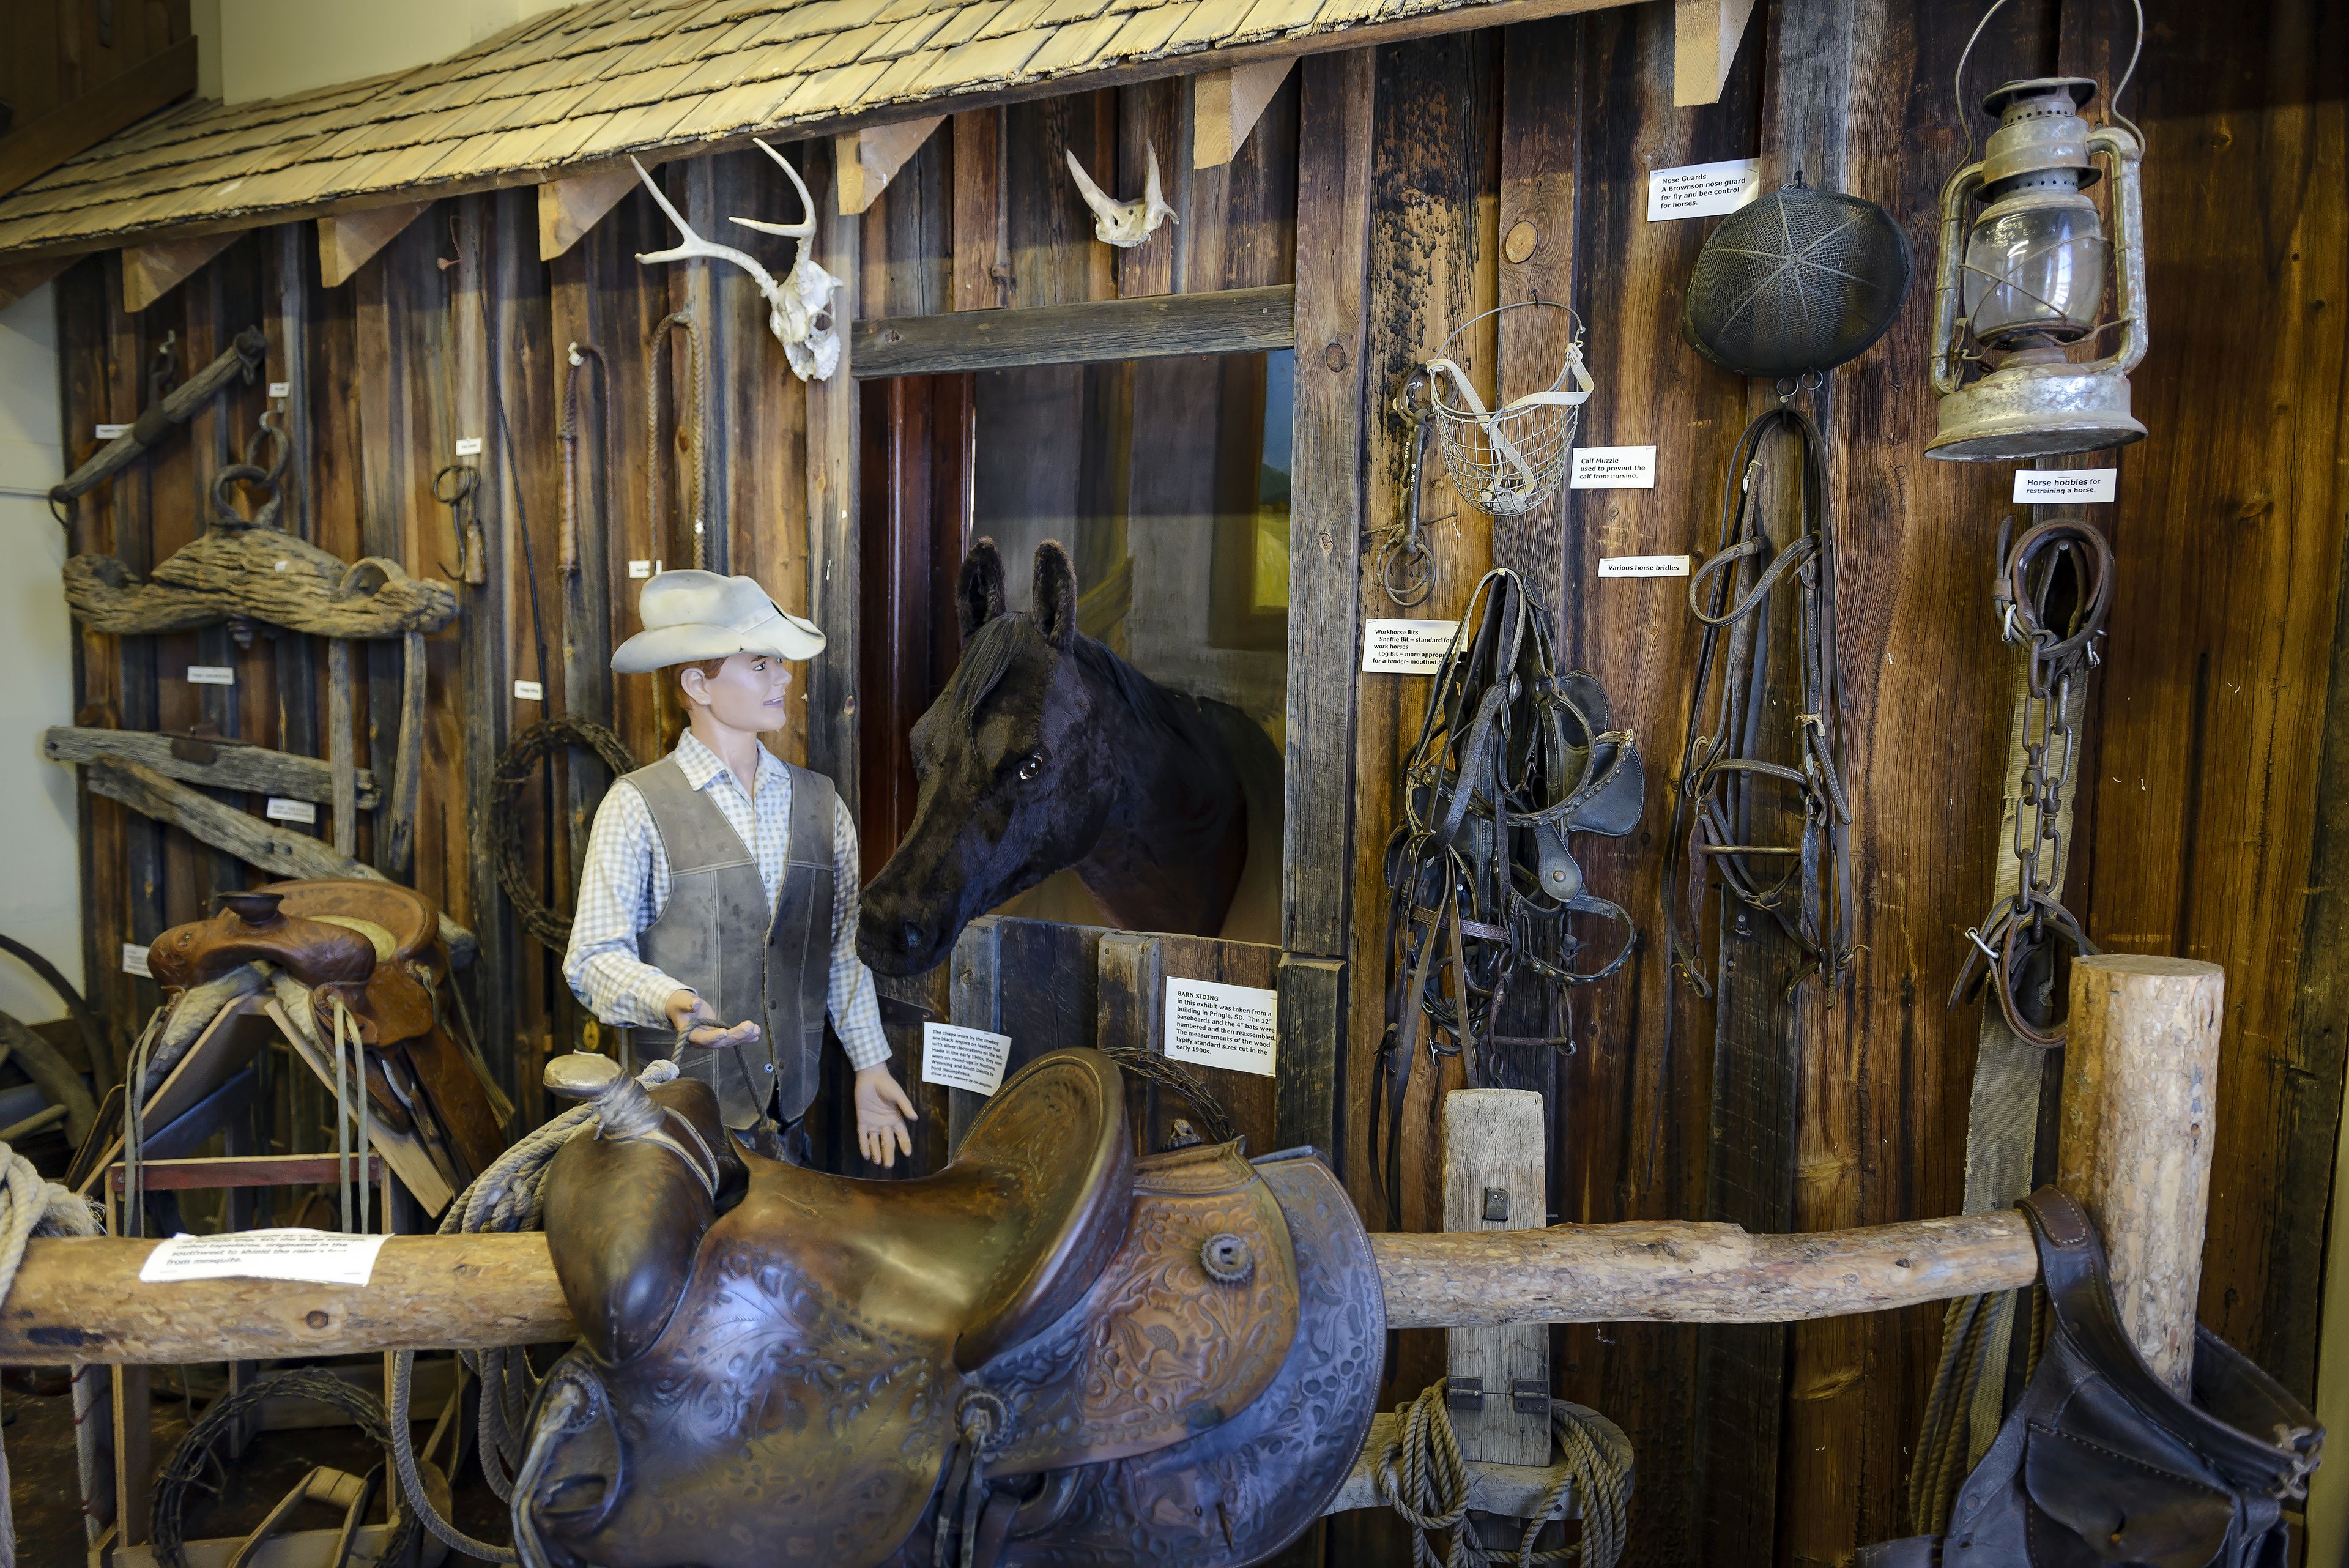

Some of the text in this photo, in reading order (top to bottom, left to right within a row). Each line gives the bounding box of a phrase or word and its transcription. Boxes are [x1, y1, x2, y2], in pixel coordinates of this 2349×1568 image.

[1682, 173, 1707, 182] Guards
[1668, 184, 1704, 192] Brownson
[1724, 177, 1746, 186] guard
[1713, 186, 1740, 195] control
[1195, 993, 1219, 1001] SIDING
[1197, 1001, 1217, 1009] exhibit
[1177, 1006, 1201, 1016] building
[1209, 1011, 1233, 1020] Pringle,
[1177, 1013, 1211, 1024] baseboards
[1176, 1021, 1206, 1031] numbered
[1236, 1031, 1276, 1041] reassembled.
[1189, 1031, 1233, 1042] measurements
[1176, 1036, 1193, 1045] typify
[1194, 1039, 1220, 1048] standard
[957, 1045, 982, 1054] decorations
[951, 1057, 974, 1066] round-ups
